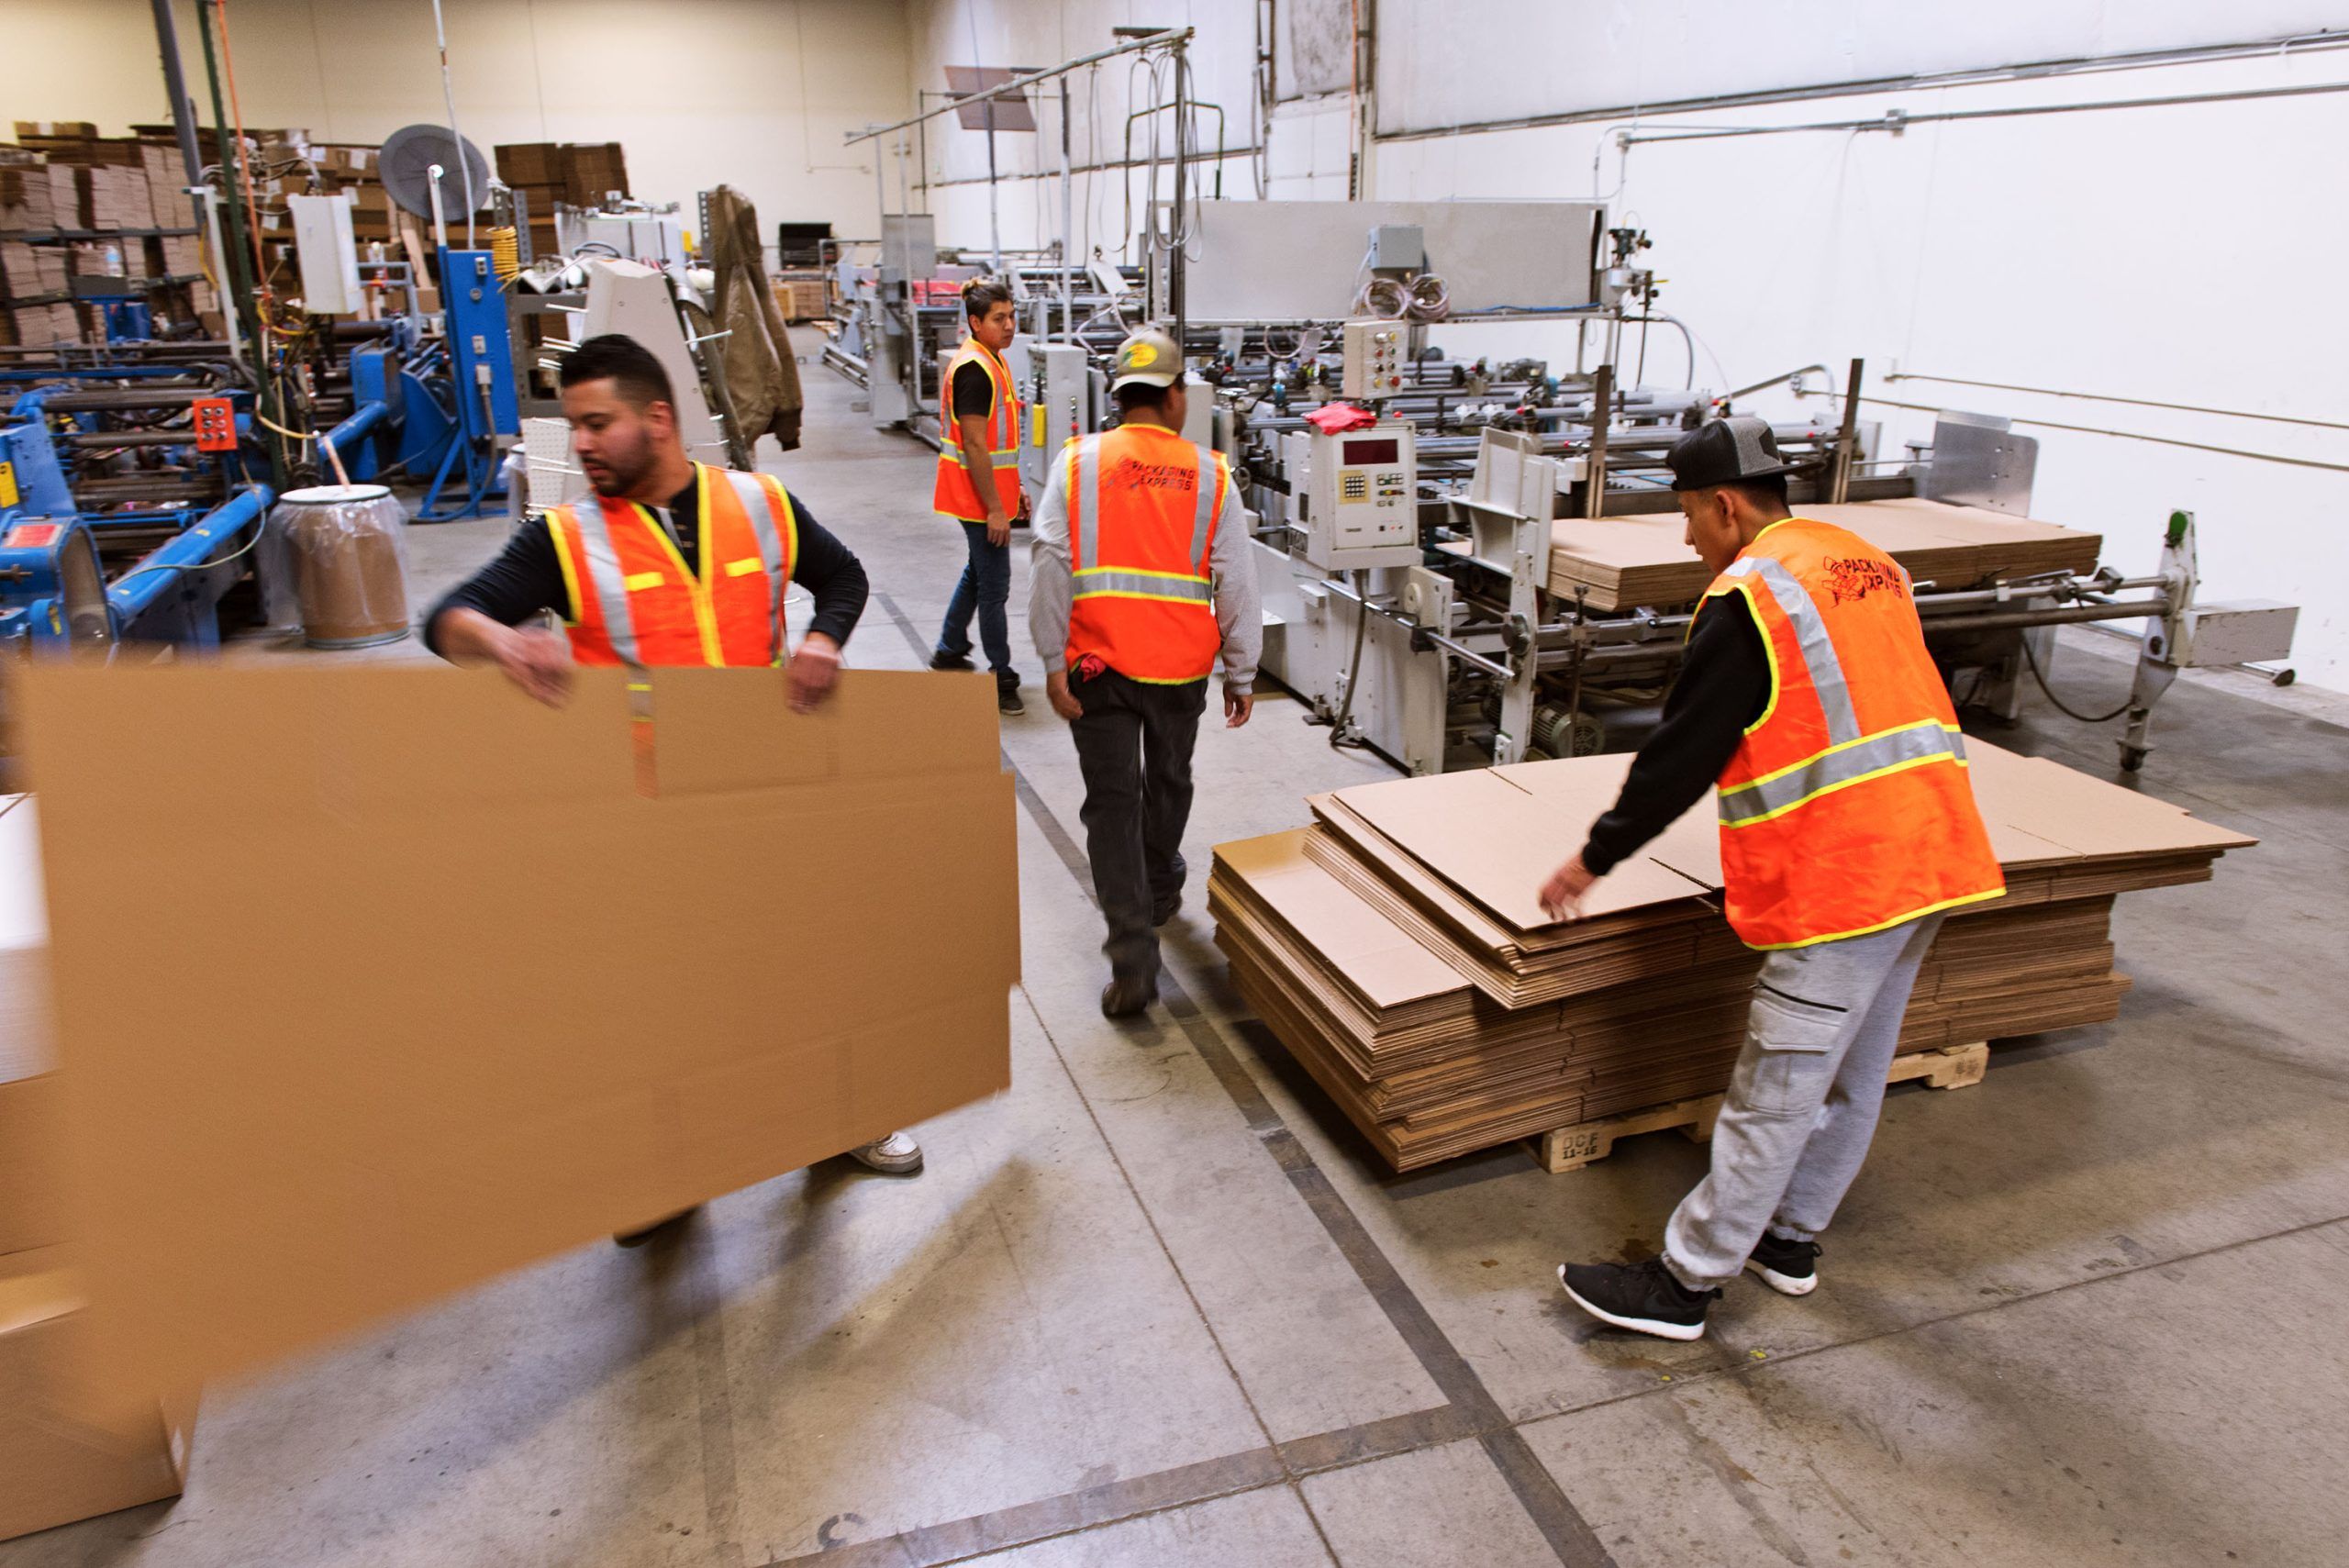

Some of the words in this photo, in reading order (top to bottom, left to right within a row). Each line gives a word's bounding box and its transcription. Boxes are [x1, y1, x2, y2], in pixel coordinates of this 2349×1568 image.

[1842, 558, 1900, 583] PACKING
[1863, 573, 1903, 599] EXPS
[1563, 1145, 1598, 1160] 11-16
